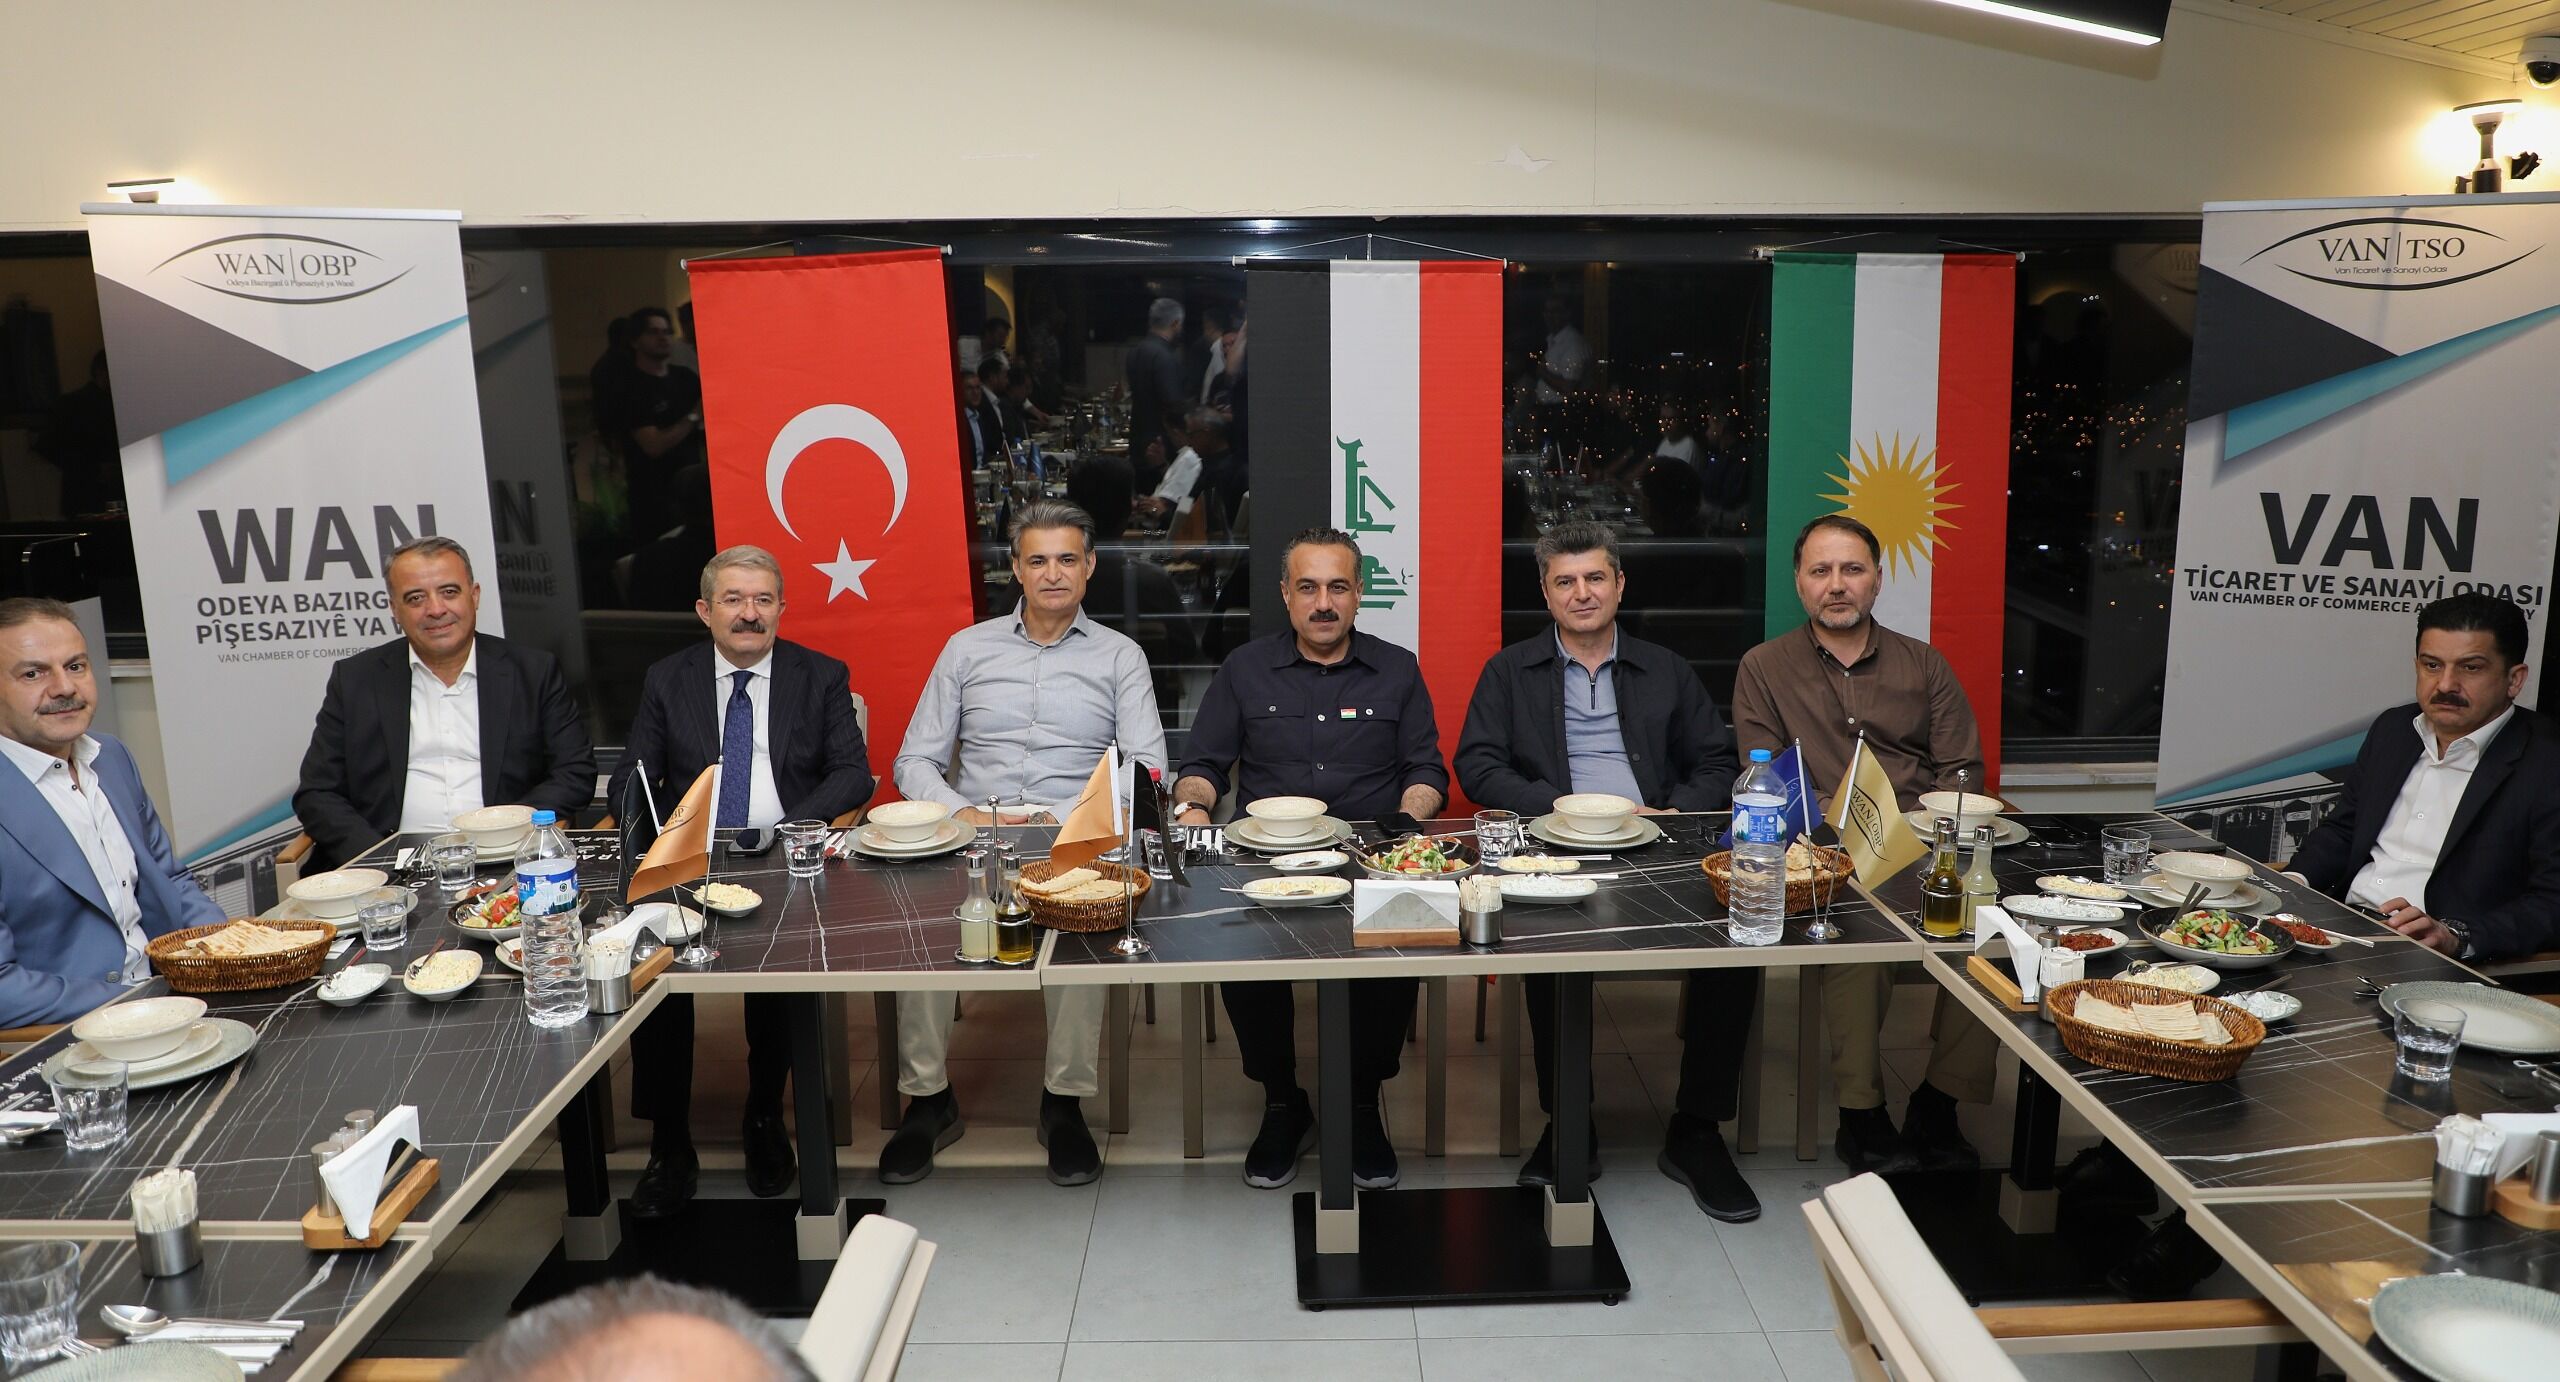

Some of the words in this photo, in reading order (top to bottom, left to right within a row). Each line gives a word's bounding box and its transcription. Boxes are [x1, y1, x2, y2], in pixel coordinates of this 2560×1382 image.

[2317, 237, 2391, 262] VAN
[2406, 237, 2466, 259] TSO
[214, 252, 286, 276] WAN
[299, 253, 357, 276] OBP
[2352, 266, 2380, 274] Ticaret
[2381, 266, 2392, 274] ve
[2393, 266, 2421, 275] Sanayi
[2259, 492, 2480, 573] VAN
[2184, 564, 2296, 592] TİCARET
[2302, 574, 2336, 594] VE
[2343, 575, 2445, 600] SANAYİ
[2452, 581, 2543, 606] ODASI
[197, 595, 288, 617] ODEYA
[293, 591, 389, 613] BAZIRG
[2190, 590, 2219, 602] VAN
[2222, 592, 2295, 607] CHAMBER
[2299, 596, 2319, 607] OF
[2322, 598, 2411, 614] COMMERCE
[196, 613, 348, 649] PÎŞESAZIYÊ
[353, 617, 387, 636] YA
[217, 653, 241, 664] VAN
[242, 650, 294, 663] CHAMBER
[296, 649, 311, 660] OF
[1852, 791, 1874, 820] WAN
[1871, 822, 1883, 847] OBP
